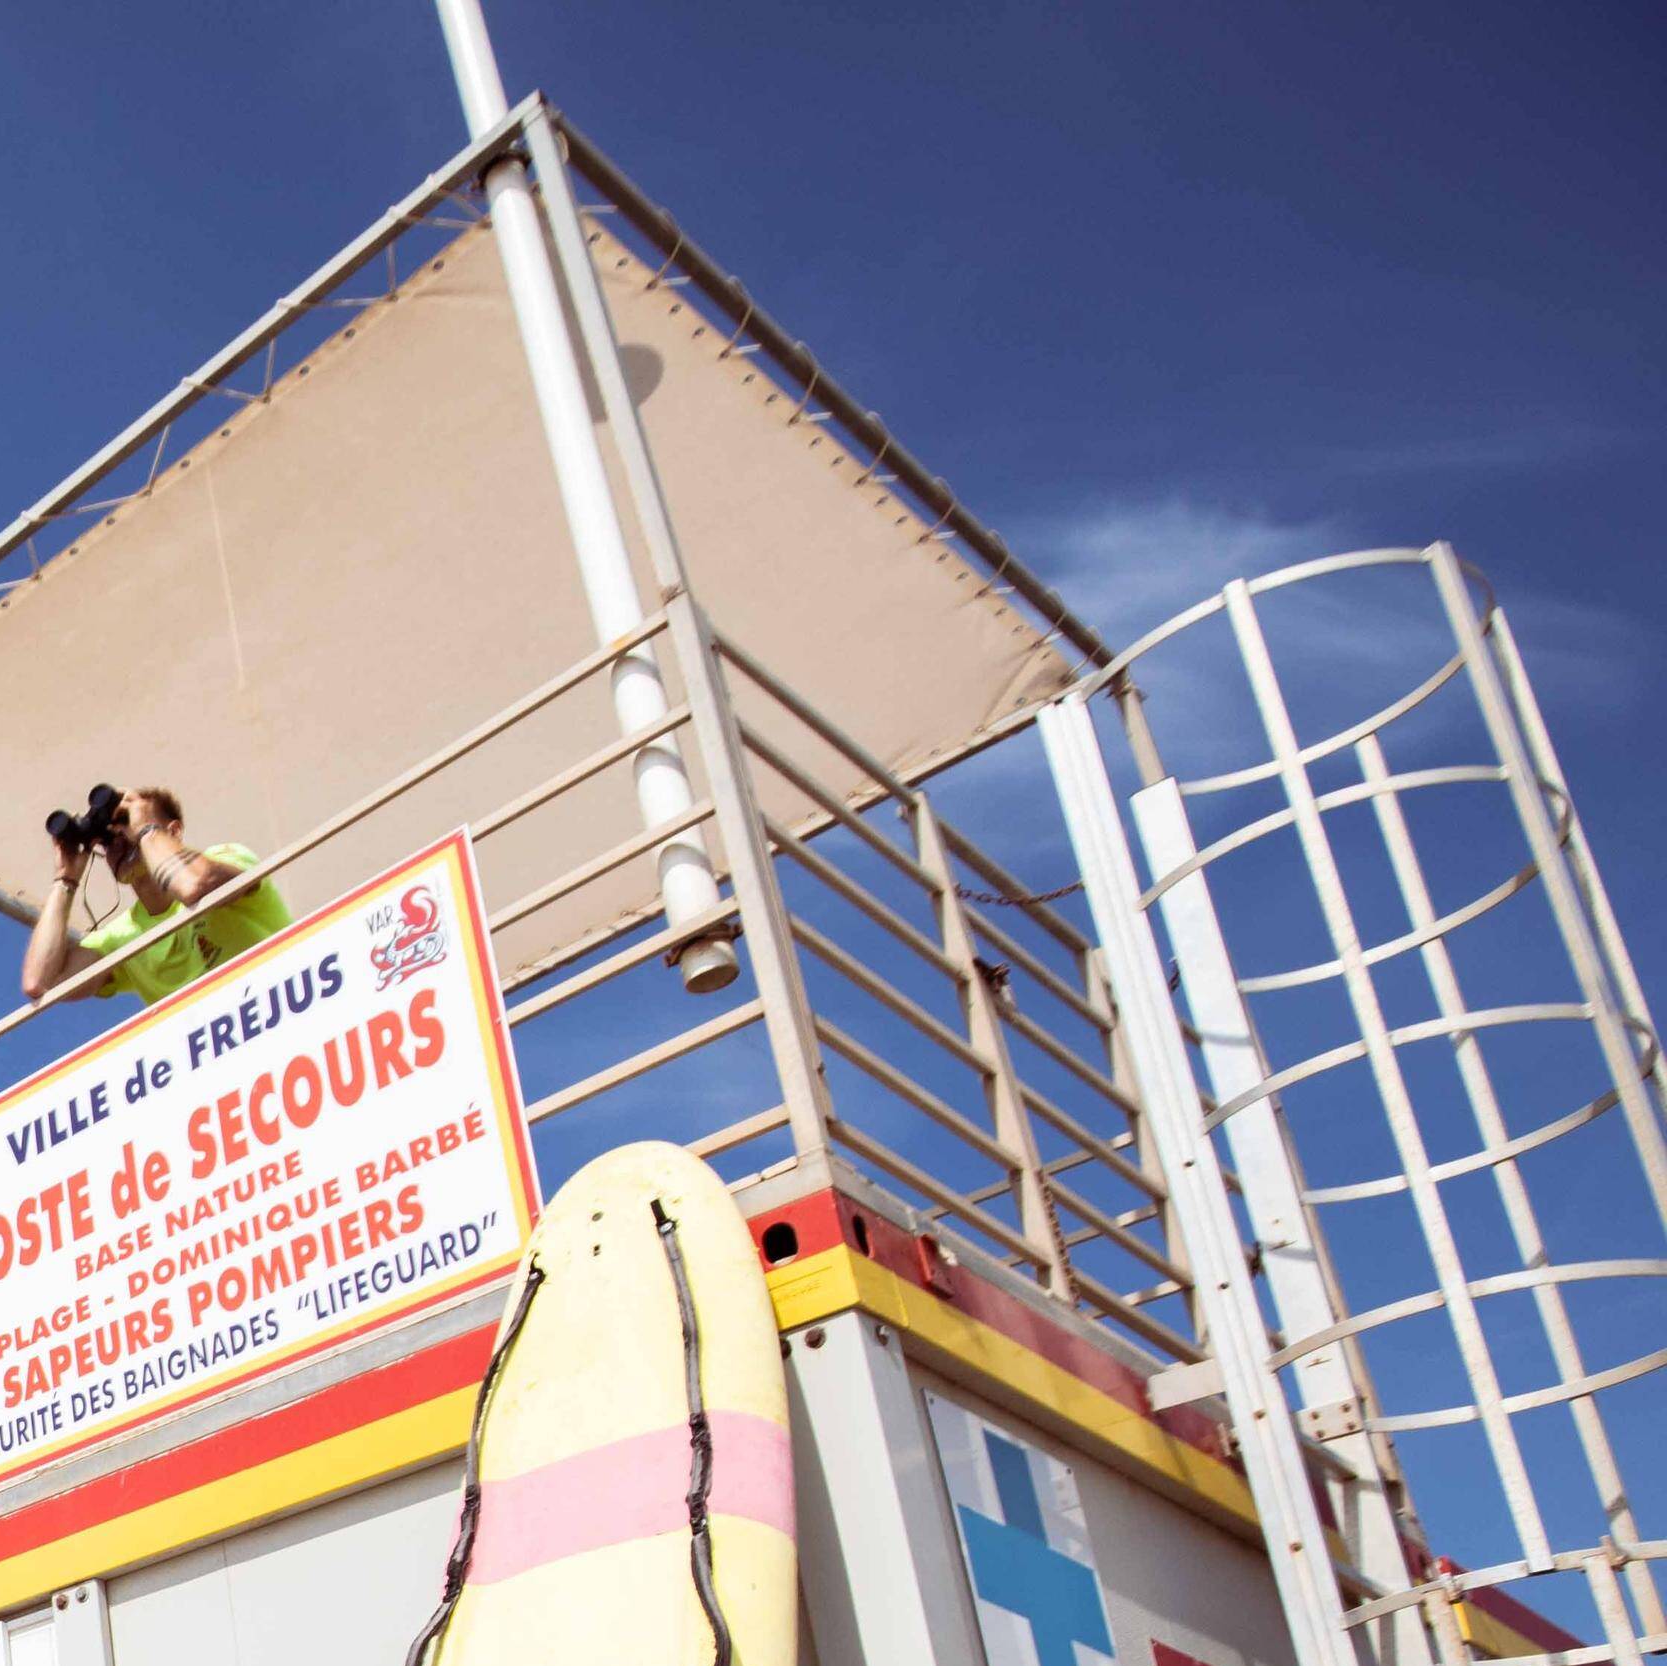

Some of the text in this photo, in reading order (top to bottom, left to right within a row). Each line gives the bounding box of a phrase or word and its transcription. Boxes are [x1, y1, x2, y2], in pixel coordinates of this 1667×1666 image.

[6, 951, 344, 1165] VILLE de FRÉJUS
[111, 1141, 171, 1220] de
[187, 988, 445, 1180] SECOURS
[3, 1184, 425, 1409] SAPEURS POMPIERS
[75, 1150, 303, 1281] BASE NATURE
[127, 1176, 343, 1299] DOMINIQUE
[355, 1102, 487, 1194] BARBÉ
[71, 1378, 116, 1423] DES
[123, 1308, 280, 1401] BAIGNADES
